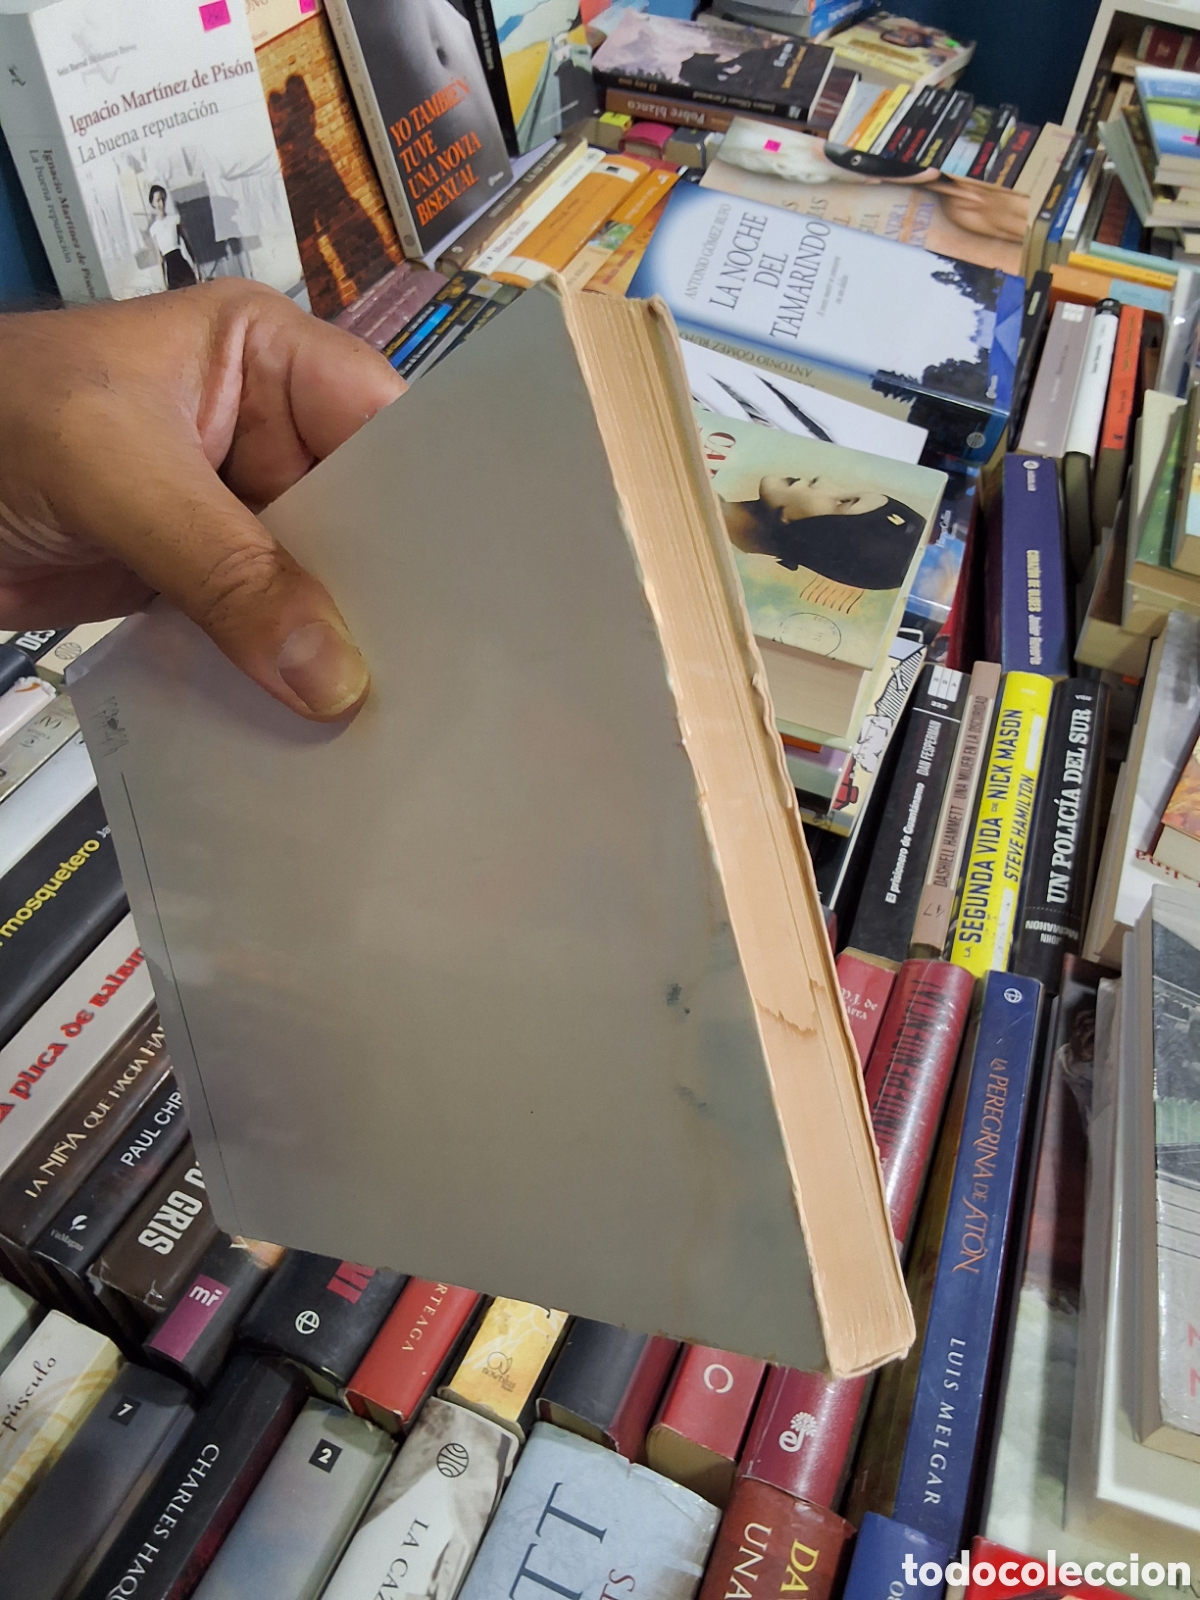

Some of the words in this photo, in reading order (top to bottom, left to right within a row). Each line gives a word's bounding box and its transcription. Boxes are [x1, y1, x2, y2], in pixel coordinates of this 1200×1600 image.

[69, 103, 120, 137] Ignacio
[121, 82, 190, 113] Martínez
[191, 69, 210, 89] de
[210, 59, 255, 83] Pisón
[78, 144, 96, 164] La
[96, 129, 140, 156] buena
[142, 99, 220, 139] reputación
[389, 119, 412, 148] YO
[399, 130, 437, 174] TUVE
[29, 149, 39, 163] La
[407, 163, 441, 200] UNA
[439, 131, 483, 176] NOVIA
[42, 149, 63, 194] Ignacio
[76, 251, 86, 266] de
[415, 163, 480, 227] BISEXUAL
[720, 211, 768, 283] NOCHE
[684, 257, 709, 299] ANTONIO
[753, 253, 788, 289] DEL
[769, 221, 831, 339] TAMARINDO
[709, 285, 743, 311] LA
[757, 355, 813, 378] ANTONIO
[921, 720, 942, 764] FESPERMAN
[1001, 708, 1023, 761] MASON
[1068, 707, 1093, 745] SUR
[916, 759, 930, 777] DAN
[959, 752, 974, 781] MUJER
[986, 756, 1012, 801] NICK
[1063, 740, 1087, 785] DEL
[904, 782, 926, 836] Guantánamo
[954, 780, 968, 801] UNA
[991, 801, 999, 813] DE
[1012, 773, 1035, 833] HAMILTON
[900, 836, 912, 849] de
[943, 804, 964, 846] HAMMETT
[973, 816, 1004, 858] VIDA
[1051, 784, 1083, 868] POLICÍA
[890, 847, 909, 894] prisionero
[933, 841, 954, 888] DASHIELL
[1004, 833, 1027, 883] STEVE
[1, 839, 100, 938] mosquetero
[885, 888, 897, 904] El
[958, 859, 996, 945] SEGUNDA
[1046, 870, 1069, 904] UN
[1040, 933, 1062, 945] JOHN
[990, 1057, 1008, 1071] LA
[40, 1131, 87, 1176] NIÑA
[83, 1098, 114, 1129] QUE
[140, 1025, 165, 1057] HA
[121, 1128, 161, 1167] PAUL
[973, 1073, 1009, 1179] PEREGRINA
[972, 1182, 989, 1202] DE
[138, 1190, 203, 1255] GRIS
[402, 1283, 449, 1352] RTEAGA
[943, 1337, 966, 1391] LUIS
[3, 1356, 57, 1432] púsculo
[117, 1402, 134, 1417] 1
[317, 1447, 334, 1465] 2
[923, 1401, 955, 1504] MELGAR
[153, 1443, 220, 1539] CHARLES
[402, 1517, 430, 1549] LA
[724, 1522, 773, 1600] UNA
